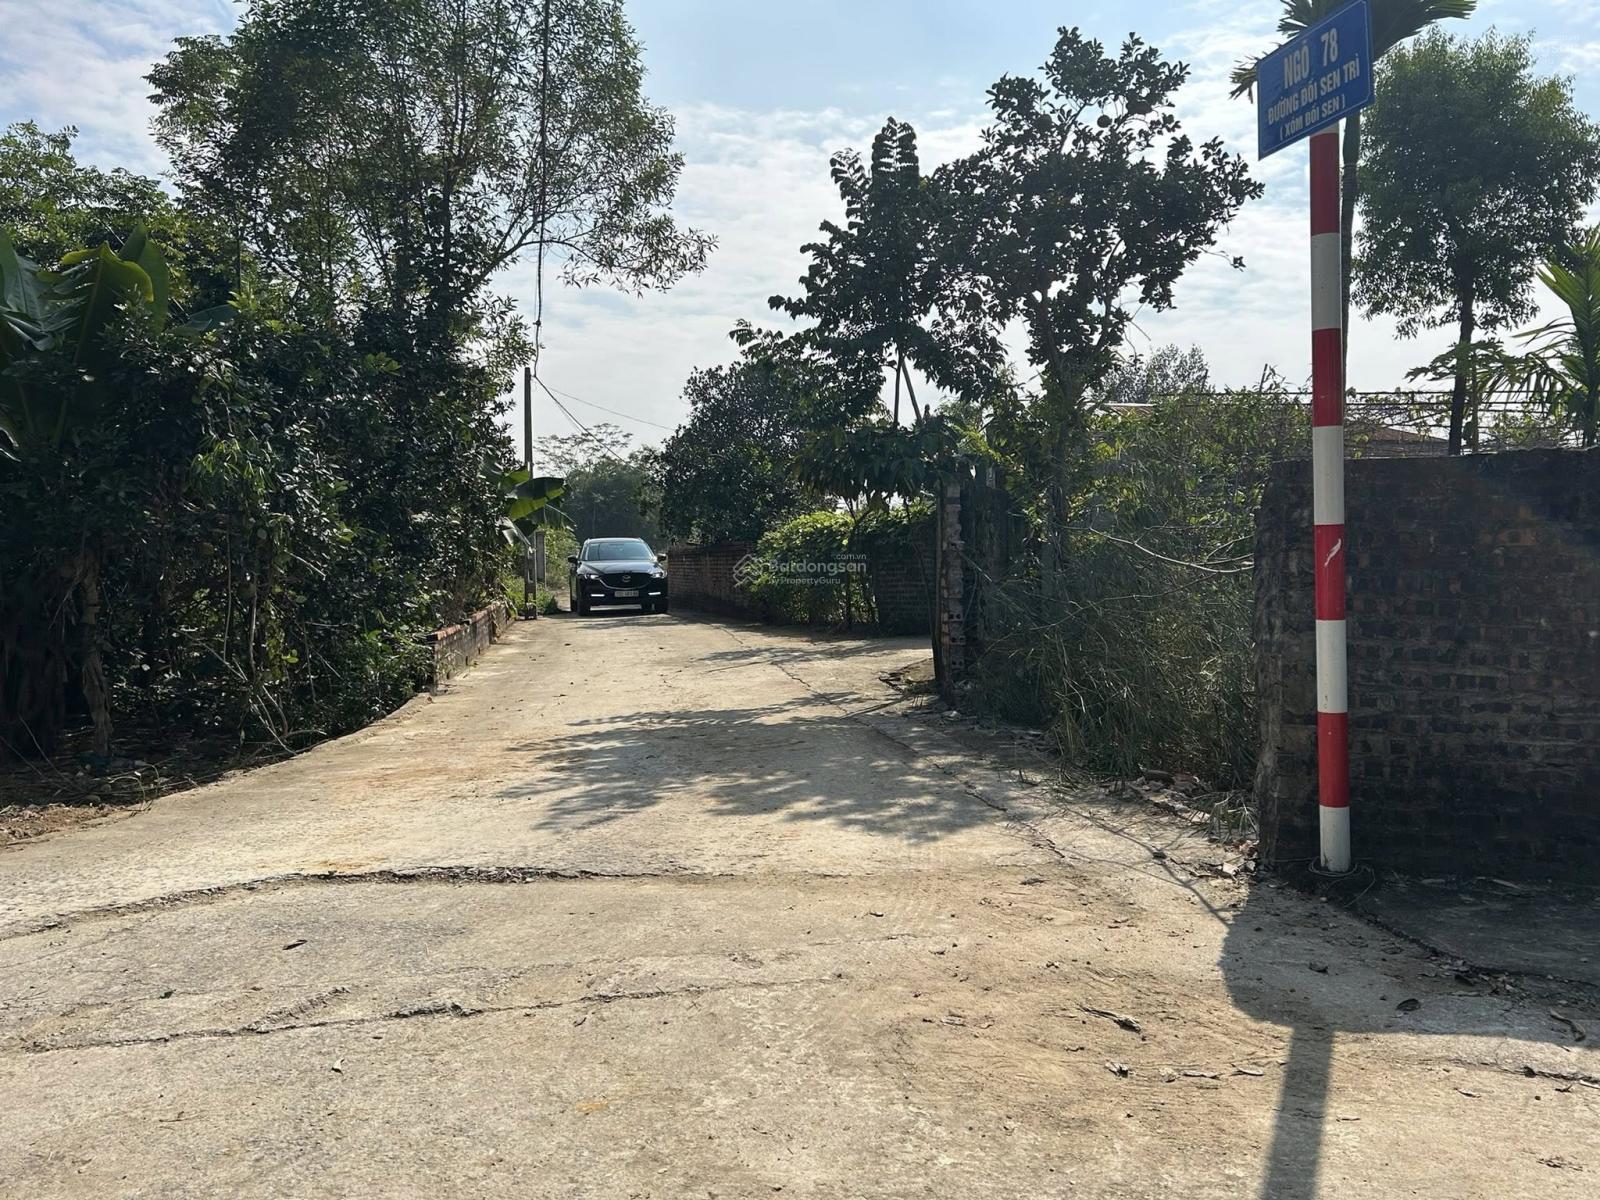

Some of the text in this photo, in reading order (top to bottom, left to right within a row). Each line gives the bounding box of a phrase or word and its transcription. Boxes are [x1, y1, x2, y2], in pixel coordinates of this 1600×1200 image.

[1321, 28, 1339, 66] 78
[1320, 68, 1341, 96] SEN
[1321, 96, 1340, 119] SEN
